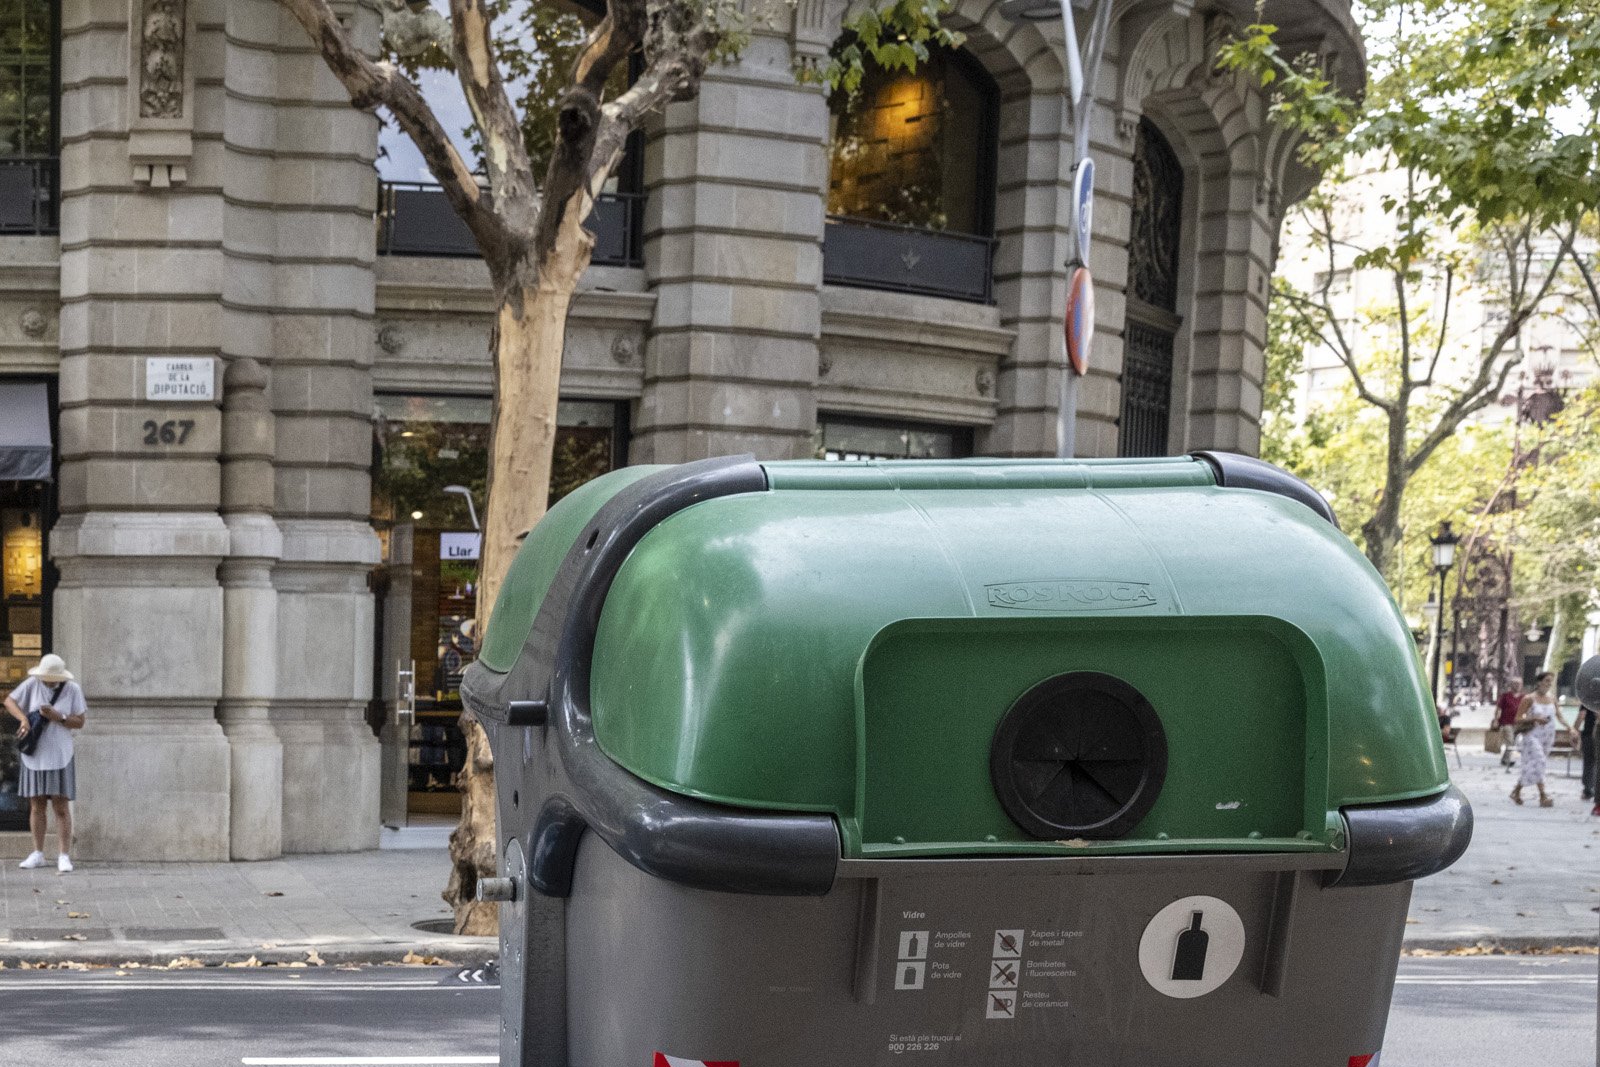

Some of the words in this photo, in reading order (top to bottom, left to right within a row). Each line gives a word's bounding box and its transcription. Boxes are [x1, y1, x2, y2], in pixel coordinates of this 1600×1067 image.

[154, 381, 207, 395] DIPUTACIÓ
[143, 420, 196, 445] 267
[449, 546, 473, 557] Llar
[902, 911, 926, 919] Vidre
[934, 931, 972, 940] Ampolles
[1030, 930, 1055, 939] Xapes
[934, 940, 943, 948] de
[944, 940, 966, 948] vidre
[1026, 960, 1066, 968] Bombetes
[930, 970, 941, 979] de
[943, 970, 962, 979] vidre
[1029, 968, 1077, 977] fluorescents
[888, 1043, 905, 1051] 900
[906, 1043, 922, 1051] 226
[923, 1042, 940, 1051] 226
